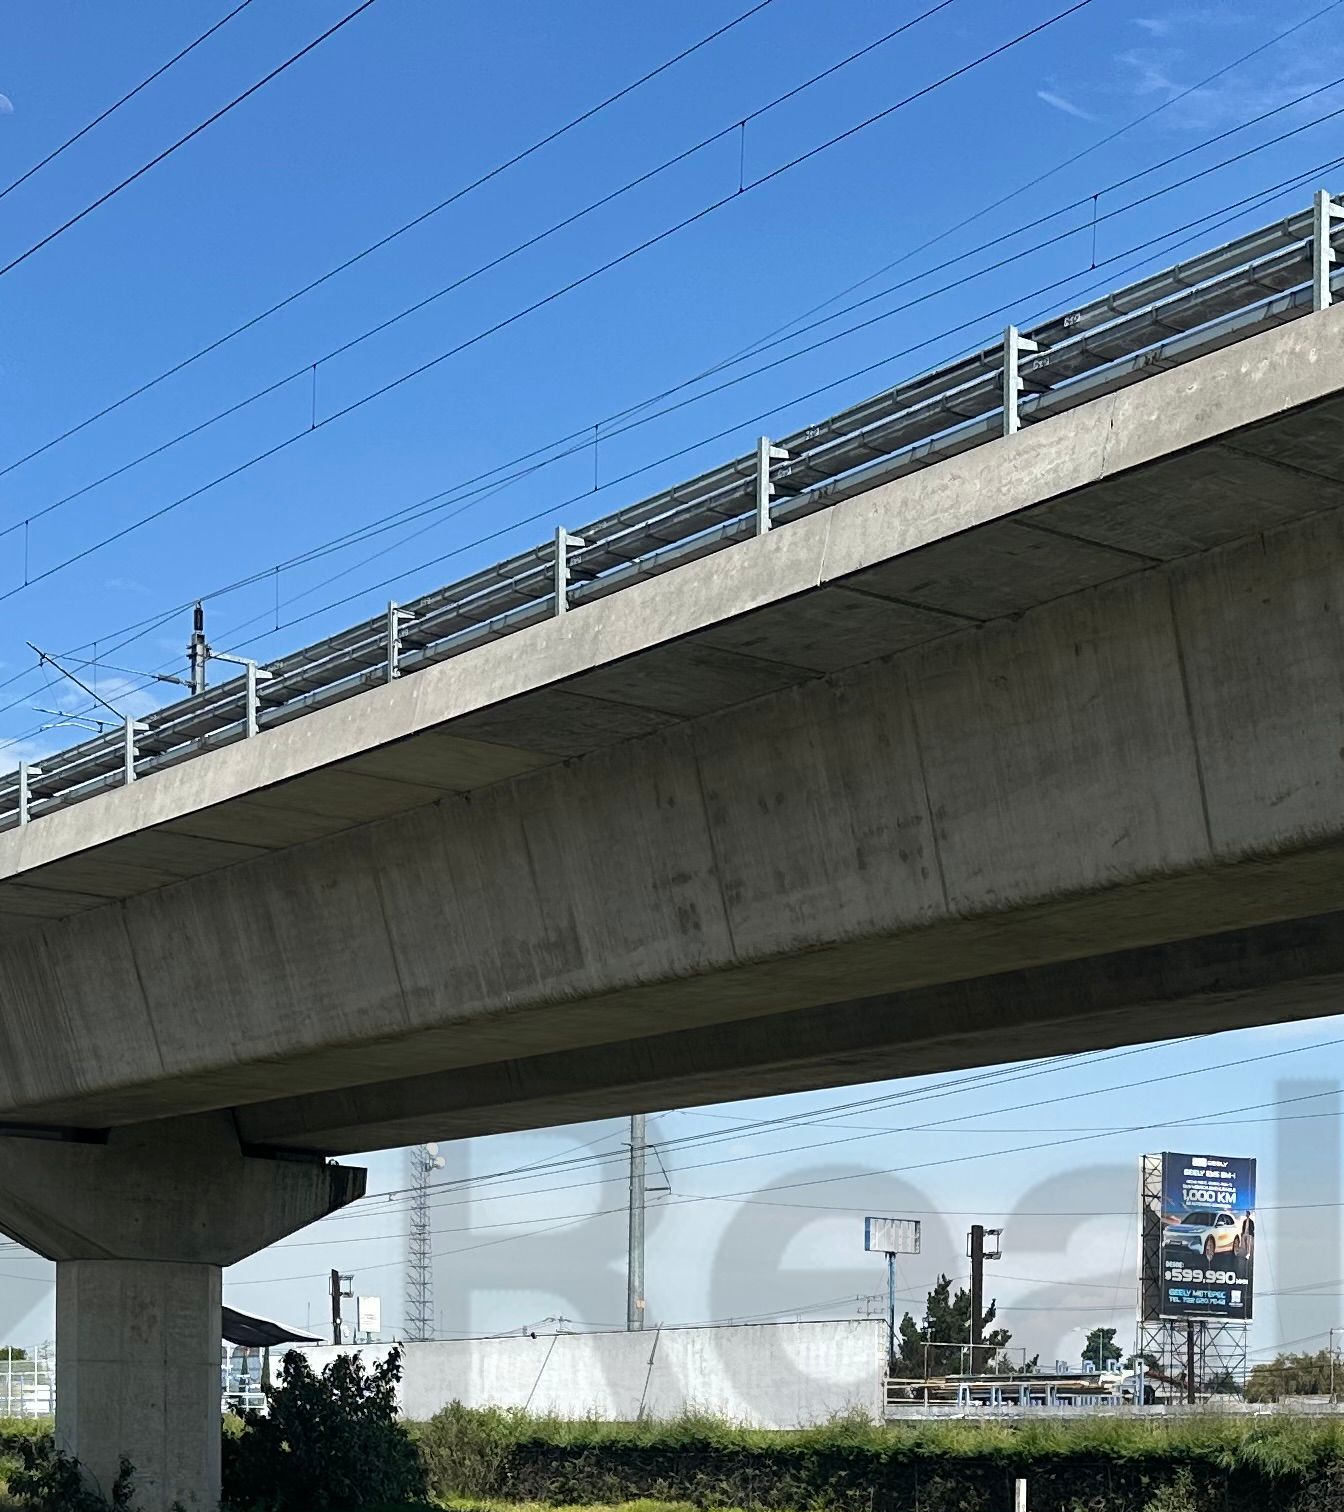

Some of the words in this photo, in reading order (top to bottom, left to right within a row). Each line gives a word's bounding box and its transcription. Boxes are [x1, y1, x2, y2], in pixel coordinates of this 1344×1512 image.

[1182, 1189, 1216, 1203] 1,000
[1217, 1191, 1236, 1204] KM
[1164, 1268, 1236, 1285] $599,990
